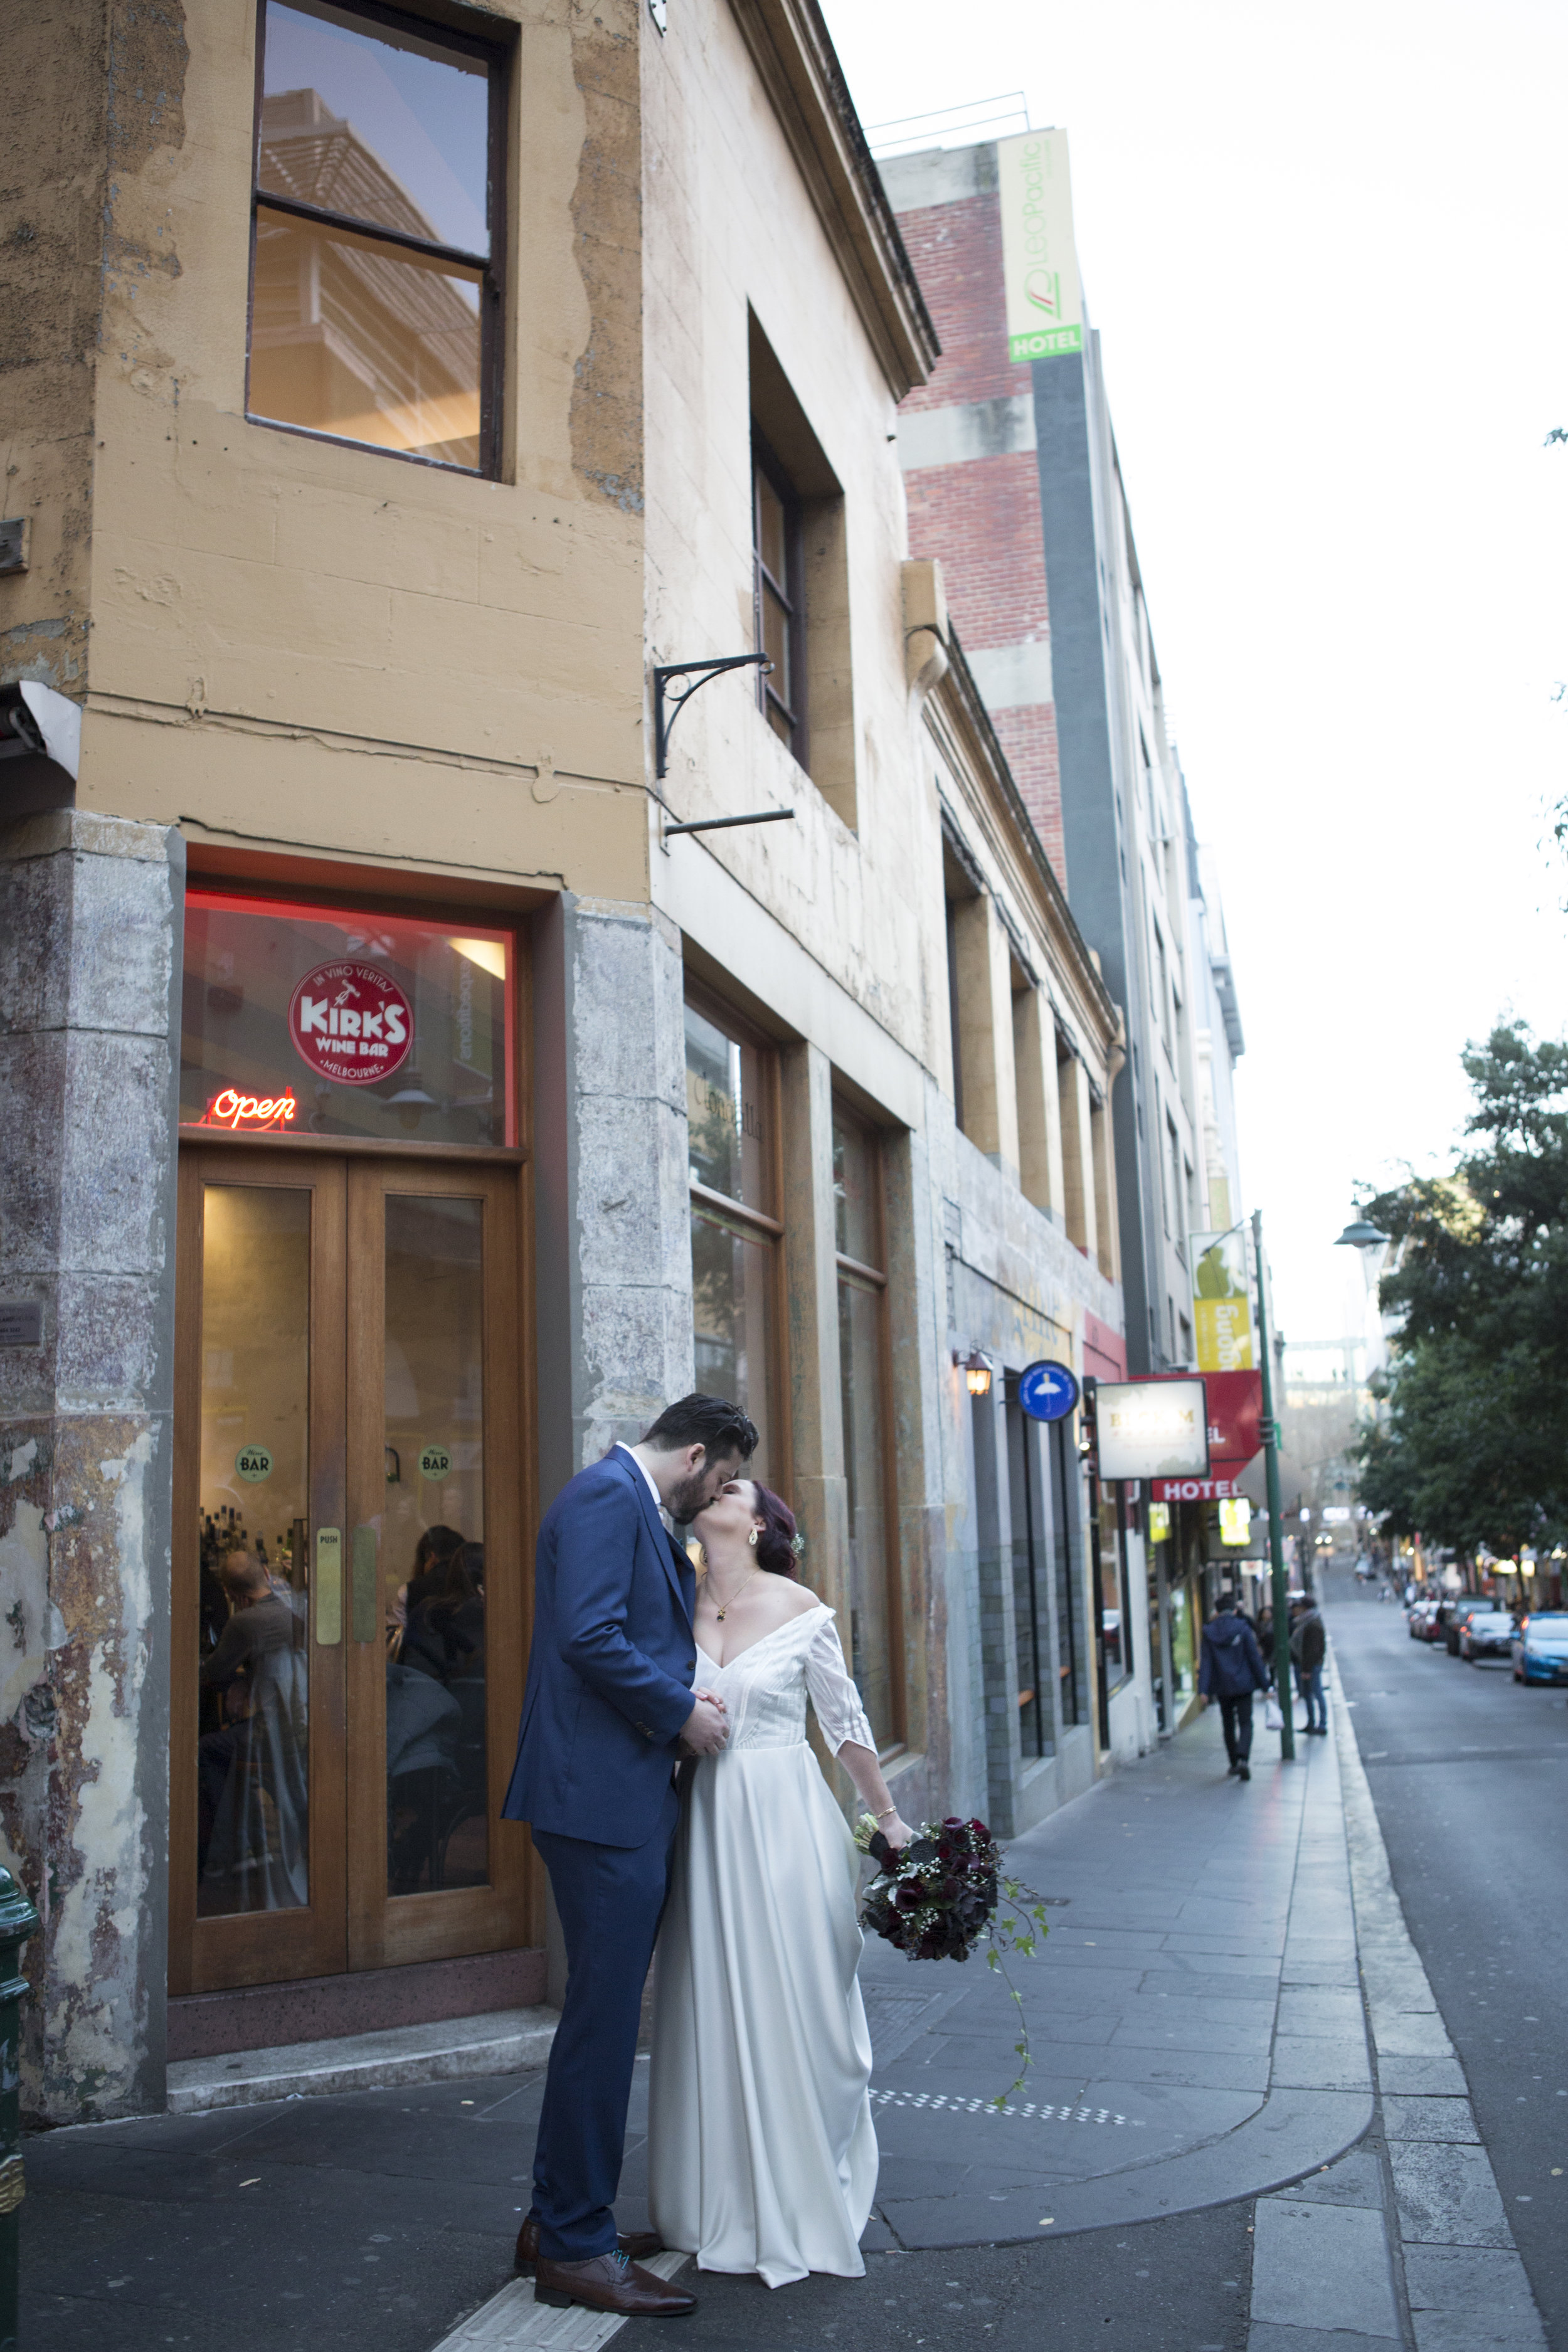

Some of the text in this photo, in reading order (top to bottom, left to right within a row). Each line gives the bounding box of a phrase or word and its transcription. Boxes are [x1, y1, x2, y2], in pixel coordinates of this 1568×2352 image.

[1013, 331, 1079, 358] HOTEL
[313, 966, 394, 992] IN VINO VERITAS
[315, 1036, 389, 1058] WINE BAR
[322, 1059, 381, 1079] MELBOURNE
[215, 1089, 296, 1129] Open
[240, 1457, 269, 1471] BAR
[422, 1456, 448, 1470] BAR
[1163, 1480, 1244, 1500] HOTEL
[320, 1535, 338, 1544] PUSH
